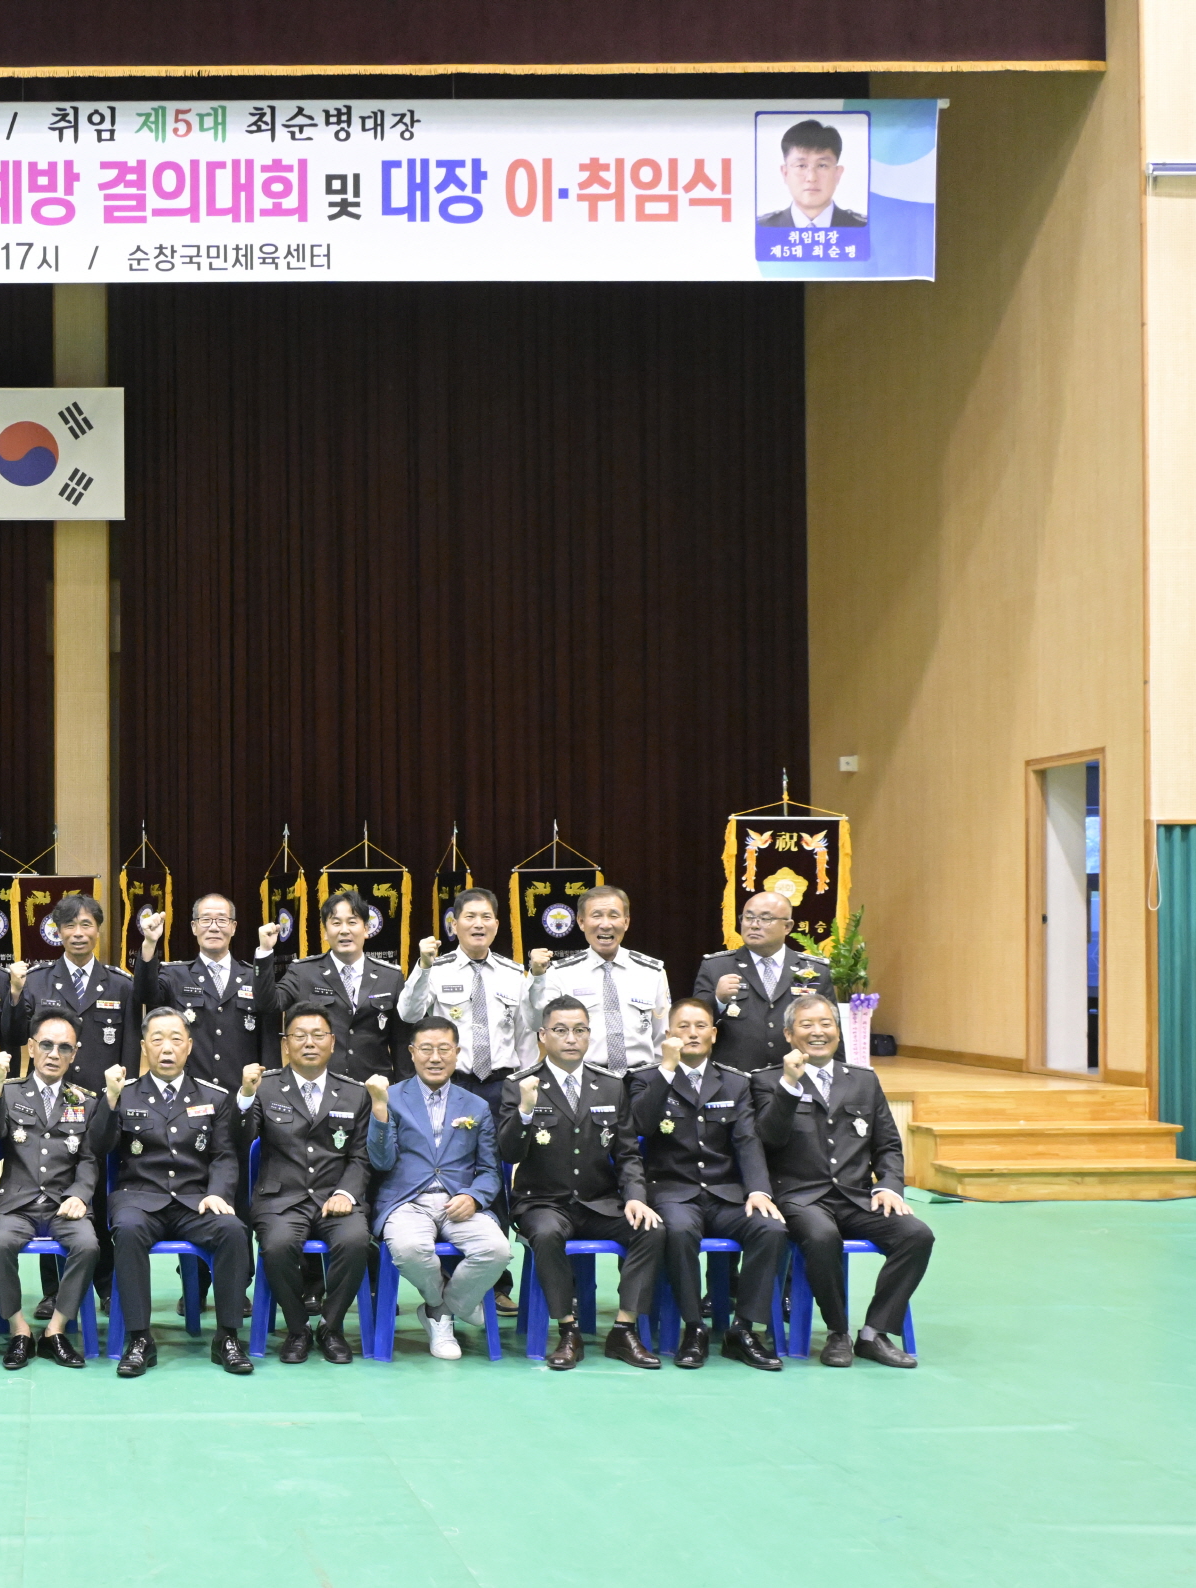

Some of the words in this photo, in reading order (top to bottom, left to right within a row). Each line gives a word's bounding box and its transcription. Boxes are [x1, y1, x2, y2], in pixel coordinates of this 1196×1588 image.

[46, 105, 118, 145] 취임
[134, 104, 228, 144] 제5대
[244, 104, 422, 143] 최순병대장
[97, 157, 309, 224] 결의대회
[324, 172, 363, 222] 및
[380, 157, 489, 225] 대장
[505, 157, 733, 223] 이·취임식
[788, 230, 840, 244] 취임대장
[0, 242, 60, 273] 17시
[127, 242, 332, 273] 순창국민체육센터
[769, 244, 803, 258] 제5대
[775, 832, 798, 852] 祝
